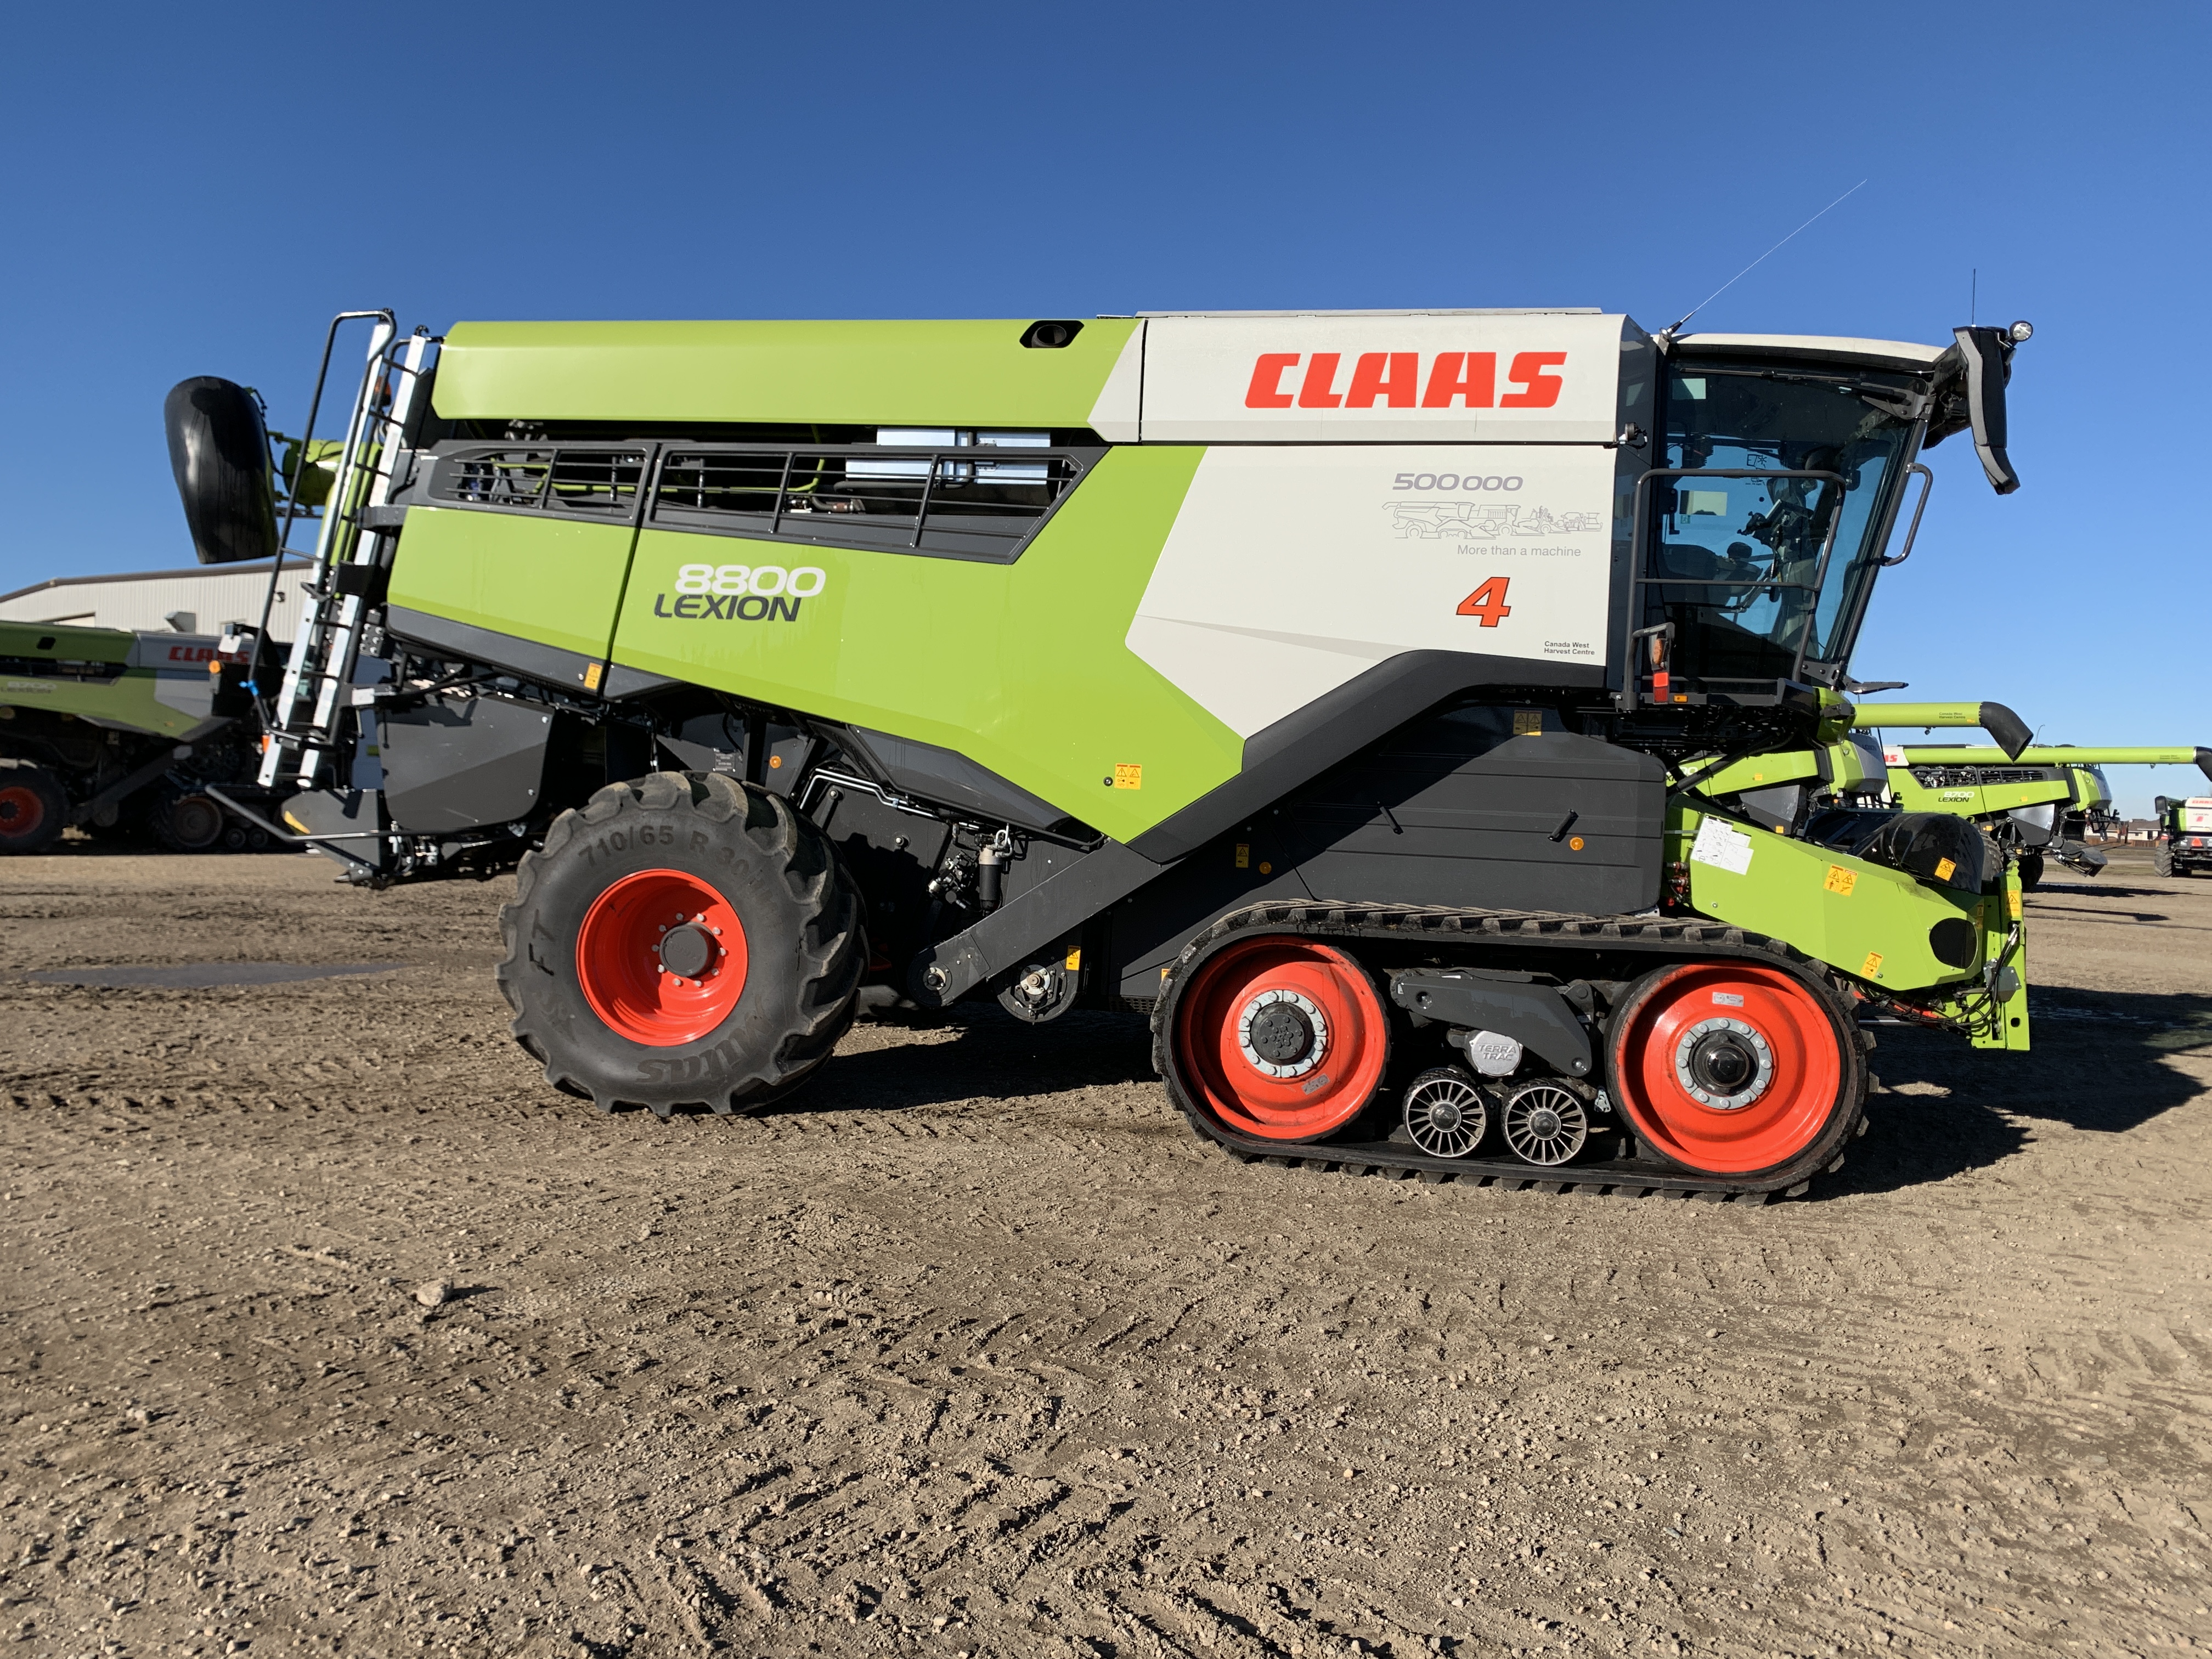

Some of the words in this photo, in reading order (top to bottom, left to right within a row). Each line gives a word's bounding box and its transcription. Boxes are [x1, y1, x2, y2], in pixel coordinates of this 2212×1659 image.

[1245, 352, 1567, 408] CLAAS
[1457, 545, 1487, 555] More
[1491, 545, 1516, 555] than
[1531, 546, 1581, 556] machine
[675, 564, 826, 597] 8800
[654, 594, 802, 622] LEXION
[1456, 577, 1511, 627] 4
[578, 825, 675, 866] 710/65
[689, 830, 709, 855] R
[1479, 1045, 1516, 1053] TERRA
[1483, 1052, 1514, 1061] TRAC
